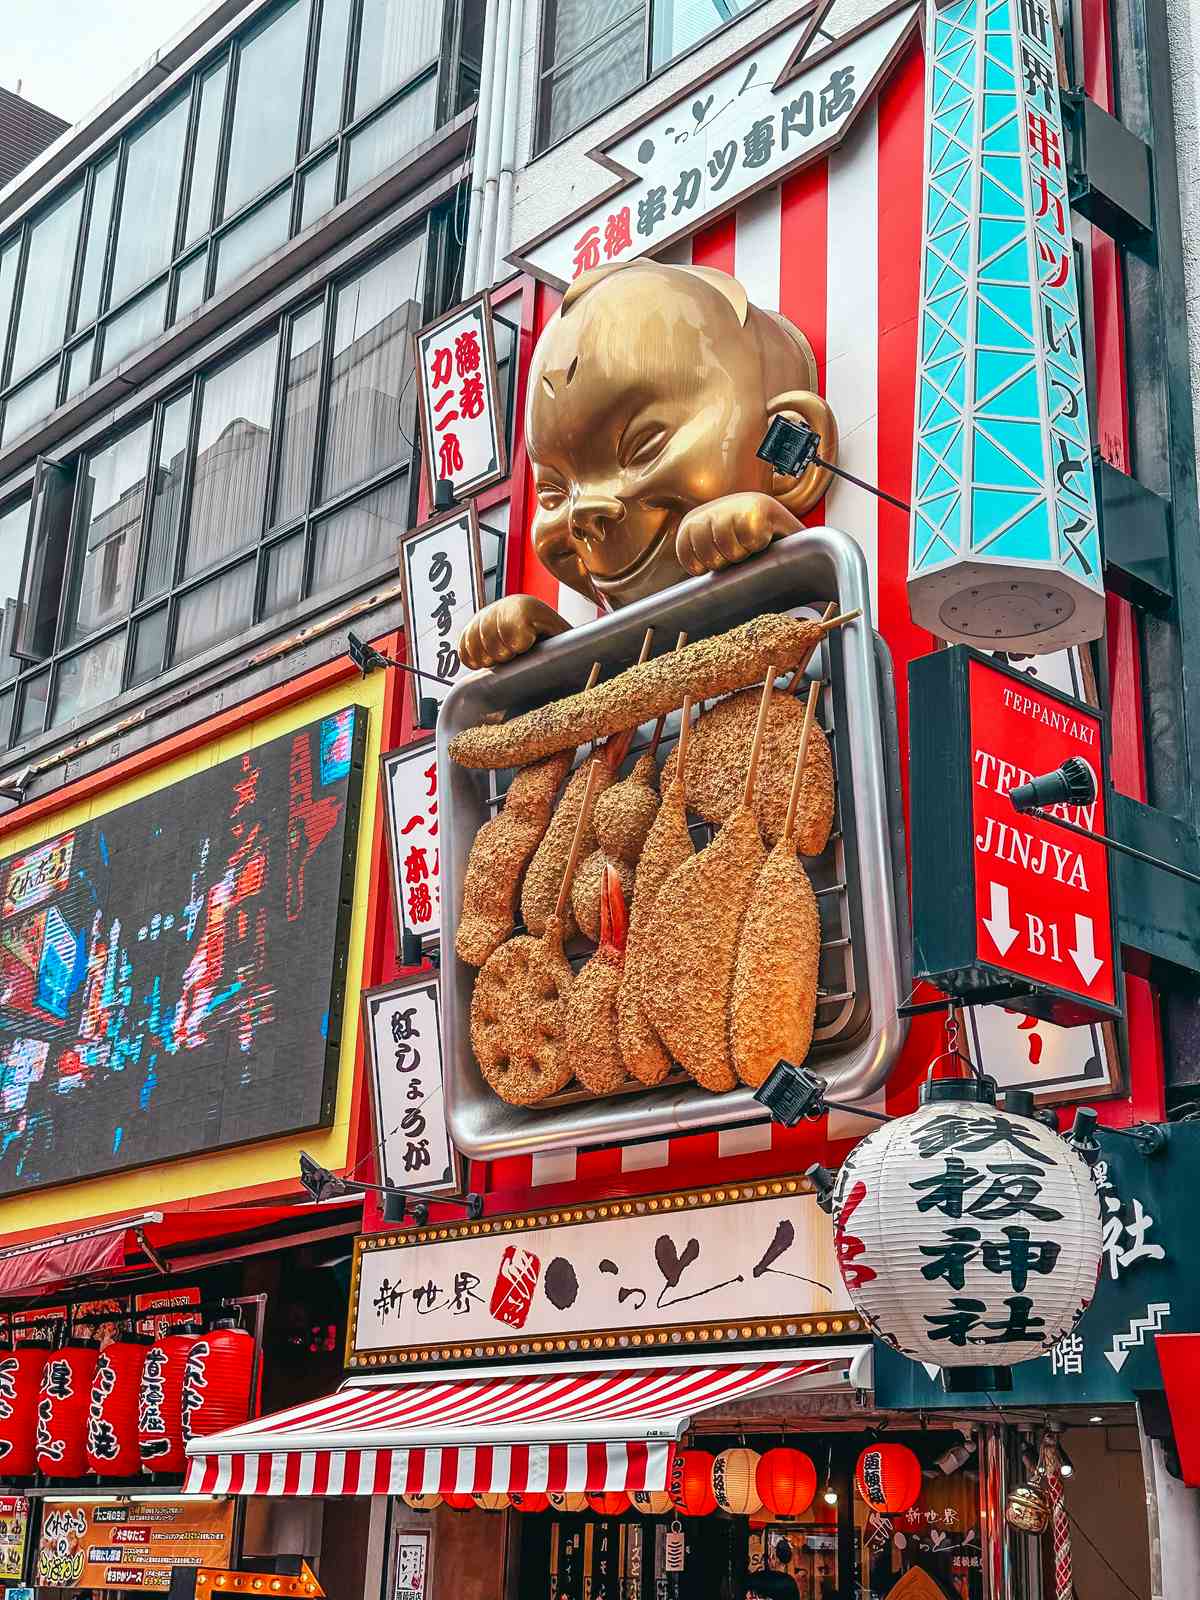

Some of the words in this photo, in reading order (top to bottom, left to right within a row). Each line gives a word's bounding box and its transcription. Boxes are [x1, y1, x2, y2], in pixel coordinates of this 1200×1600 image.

[571, 65, 857, 280] 元祖串カツ専門店
[1003, 688, 1096, 746] TEPPANYAKI
[975, 817, 1090, 893] JINJYA
[1025, 912, 1064, 963] B1
[390, 1007, 431, 1173] 紅しょうが
[909, 1114, 1065, 1346] 鉄板神社
[373, 1271, 486, 1328] 新世界
